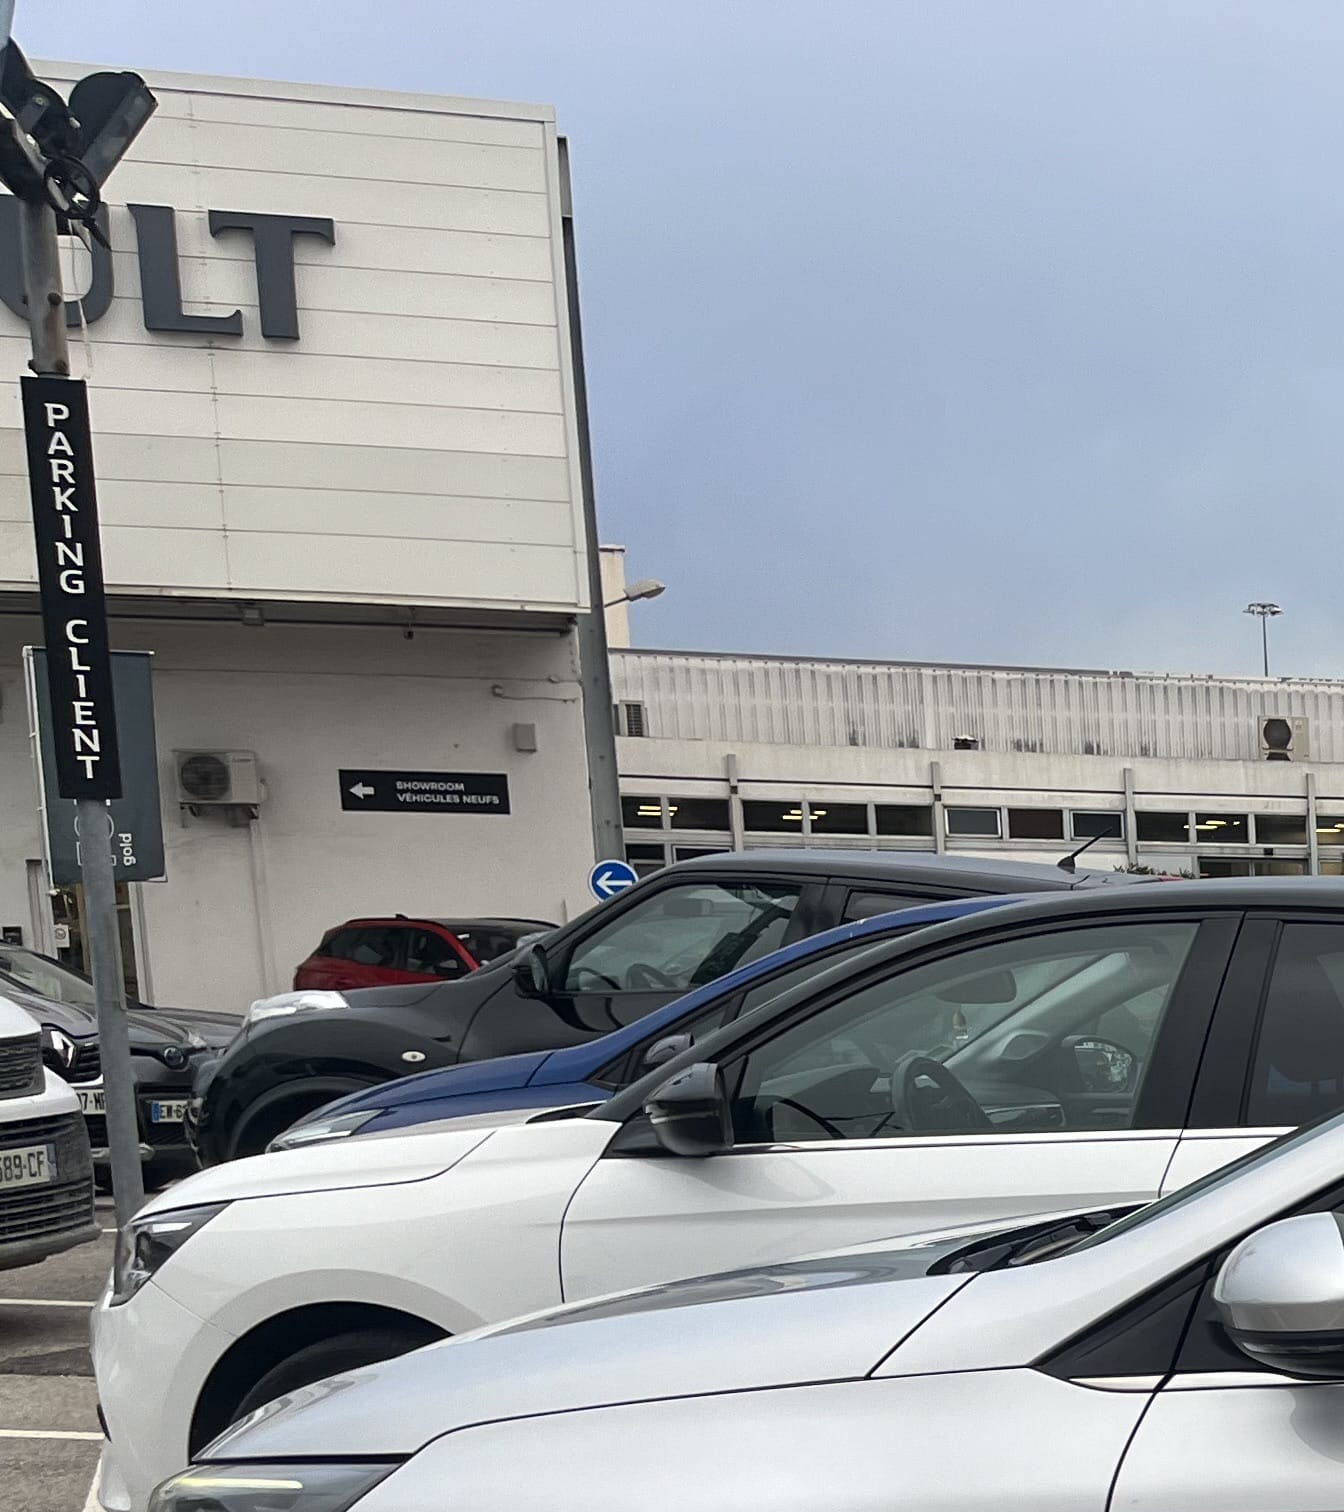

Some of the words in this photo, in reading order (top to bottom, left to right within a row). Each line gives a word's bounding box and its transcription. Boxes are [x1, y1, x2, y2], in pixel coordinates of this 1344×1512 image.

[43, 402, 86, 595] PARKING
[65, 619, 101, 780] CLIENT
[396, 781, 465, 791] SHOWROOM
[396, 792, 460, 803] VÉHICULES
[463, 794, 500, 804] NEUFS
[118, 833, 136, 866] gold
[0, 1151, 44, 1182] 89-CF
